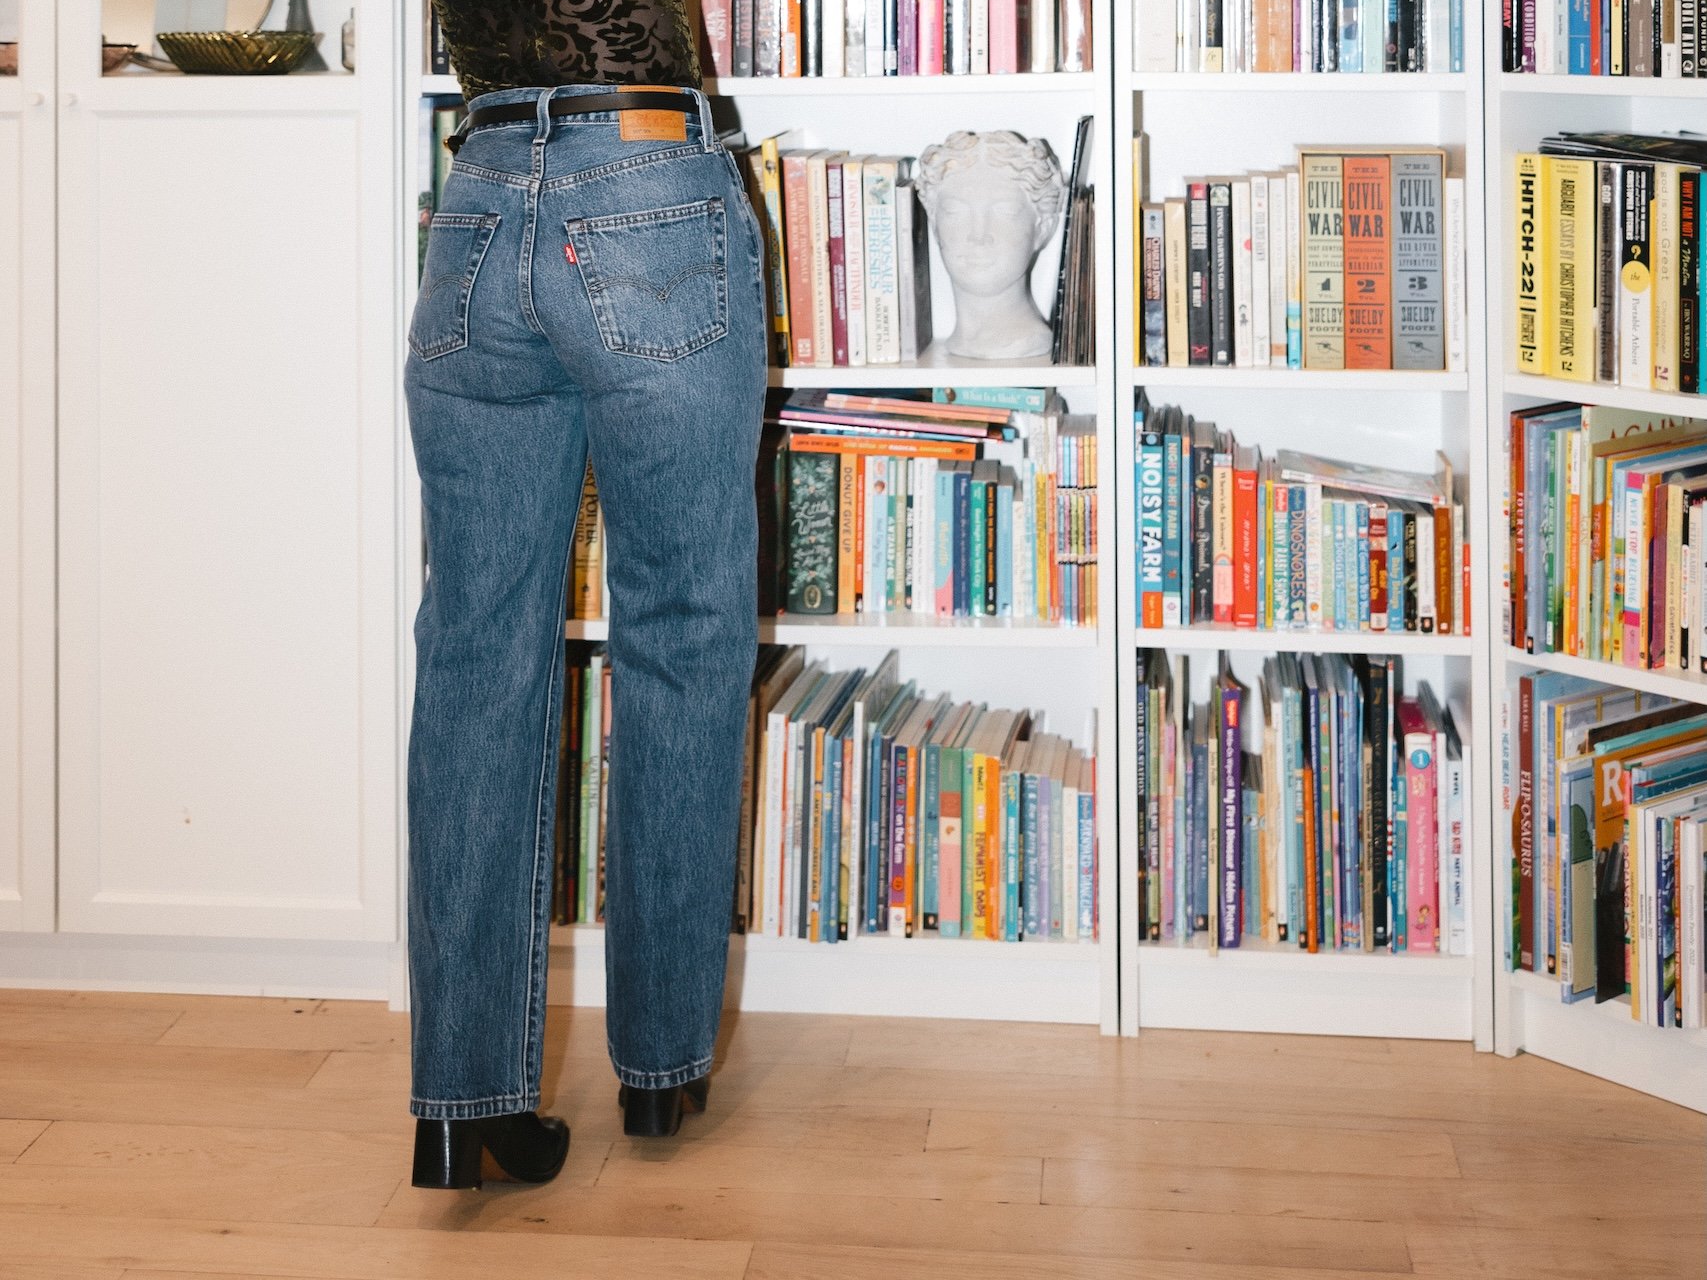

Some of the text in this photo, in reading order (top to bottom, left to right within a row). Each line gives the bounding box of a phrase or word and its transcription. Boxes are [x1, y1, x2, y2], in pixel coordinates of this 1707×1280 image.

[1525, 0, 1535, 48] CONDITION
[1682, 34, 1694, 55] MAN
[1308, 180, 1342, 208] CIVIL
[1348, 182, 1383, 210] CIVIL
[1400, 178, 1435, 207] CIVIL
[1308, 213, 1344, 236] WAR
[1349, 215, 1384, 238] WAR
[1400, 212, 1436, 234] WAR
[1522, 180, 1534, 292] HITCH-22
[868, 216, 881, 290] HERESIES
[882, 217, 894, 294] DINOSAUR
[1152, 239, 1162, 300] CHARLES DARWIN
[1560, 179, 1575, 356] ARGUABLY ESSAYS BY CHRISTOPHER HITCHENS
[849, 251, 861, 311] FACTFINDER
[1320, 278, 1331, 291] 1
[1356, 280, 1376, 293] 2
[1408, 276, 1428, 290] 3
[1309, 308, 1343, 323] SHELBY
[1350, 310, 1384, 325] SHELBY
[1401, 306, 1436, 322] SHELBY
[1632, 298, 1640, 366] Portable Atheist
[1683, 309, 1692, 359] IBN WARRAQ
[843, 466, 852, 553] DONUT GIVE UP
[1168, 442, 1177, 539] NIGHT NIGHT FARM
[586, 494, 598, 546] POTTER
[1142, 452, 1162, 582] NOISY FARM
[1198, 495, 1210, 572] Dream Animals
[1516, 491, 1524, 554] JOURNEY
[1291, 510, 1305, 598] DINOSNORES
[1628, 498, 1639, 603] NEVER STOP BELIEVING
[588, 756, 598, 808] WAITING
[1224, 788, 1236, 804] My
[1226, 805, 1236, 827] First
[1520, 770, 1532, 877] FLIP-O-SAURUS
[976, 832, 987, 882] FEMINIST
[1226, 829, 1236, 868] Dinosaur
[1226, 871, 1236, 902] Hidden
[1226, 904, 1237, 942] Pictures
